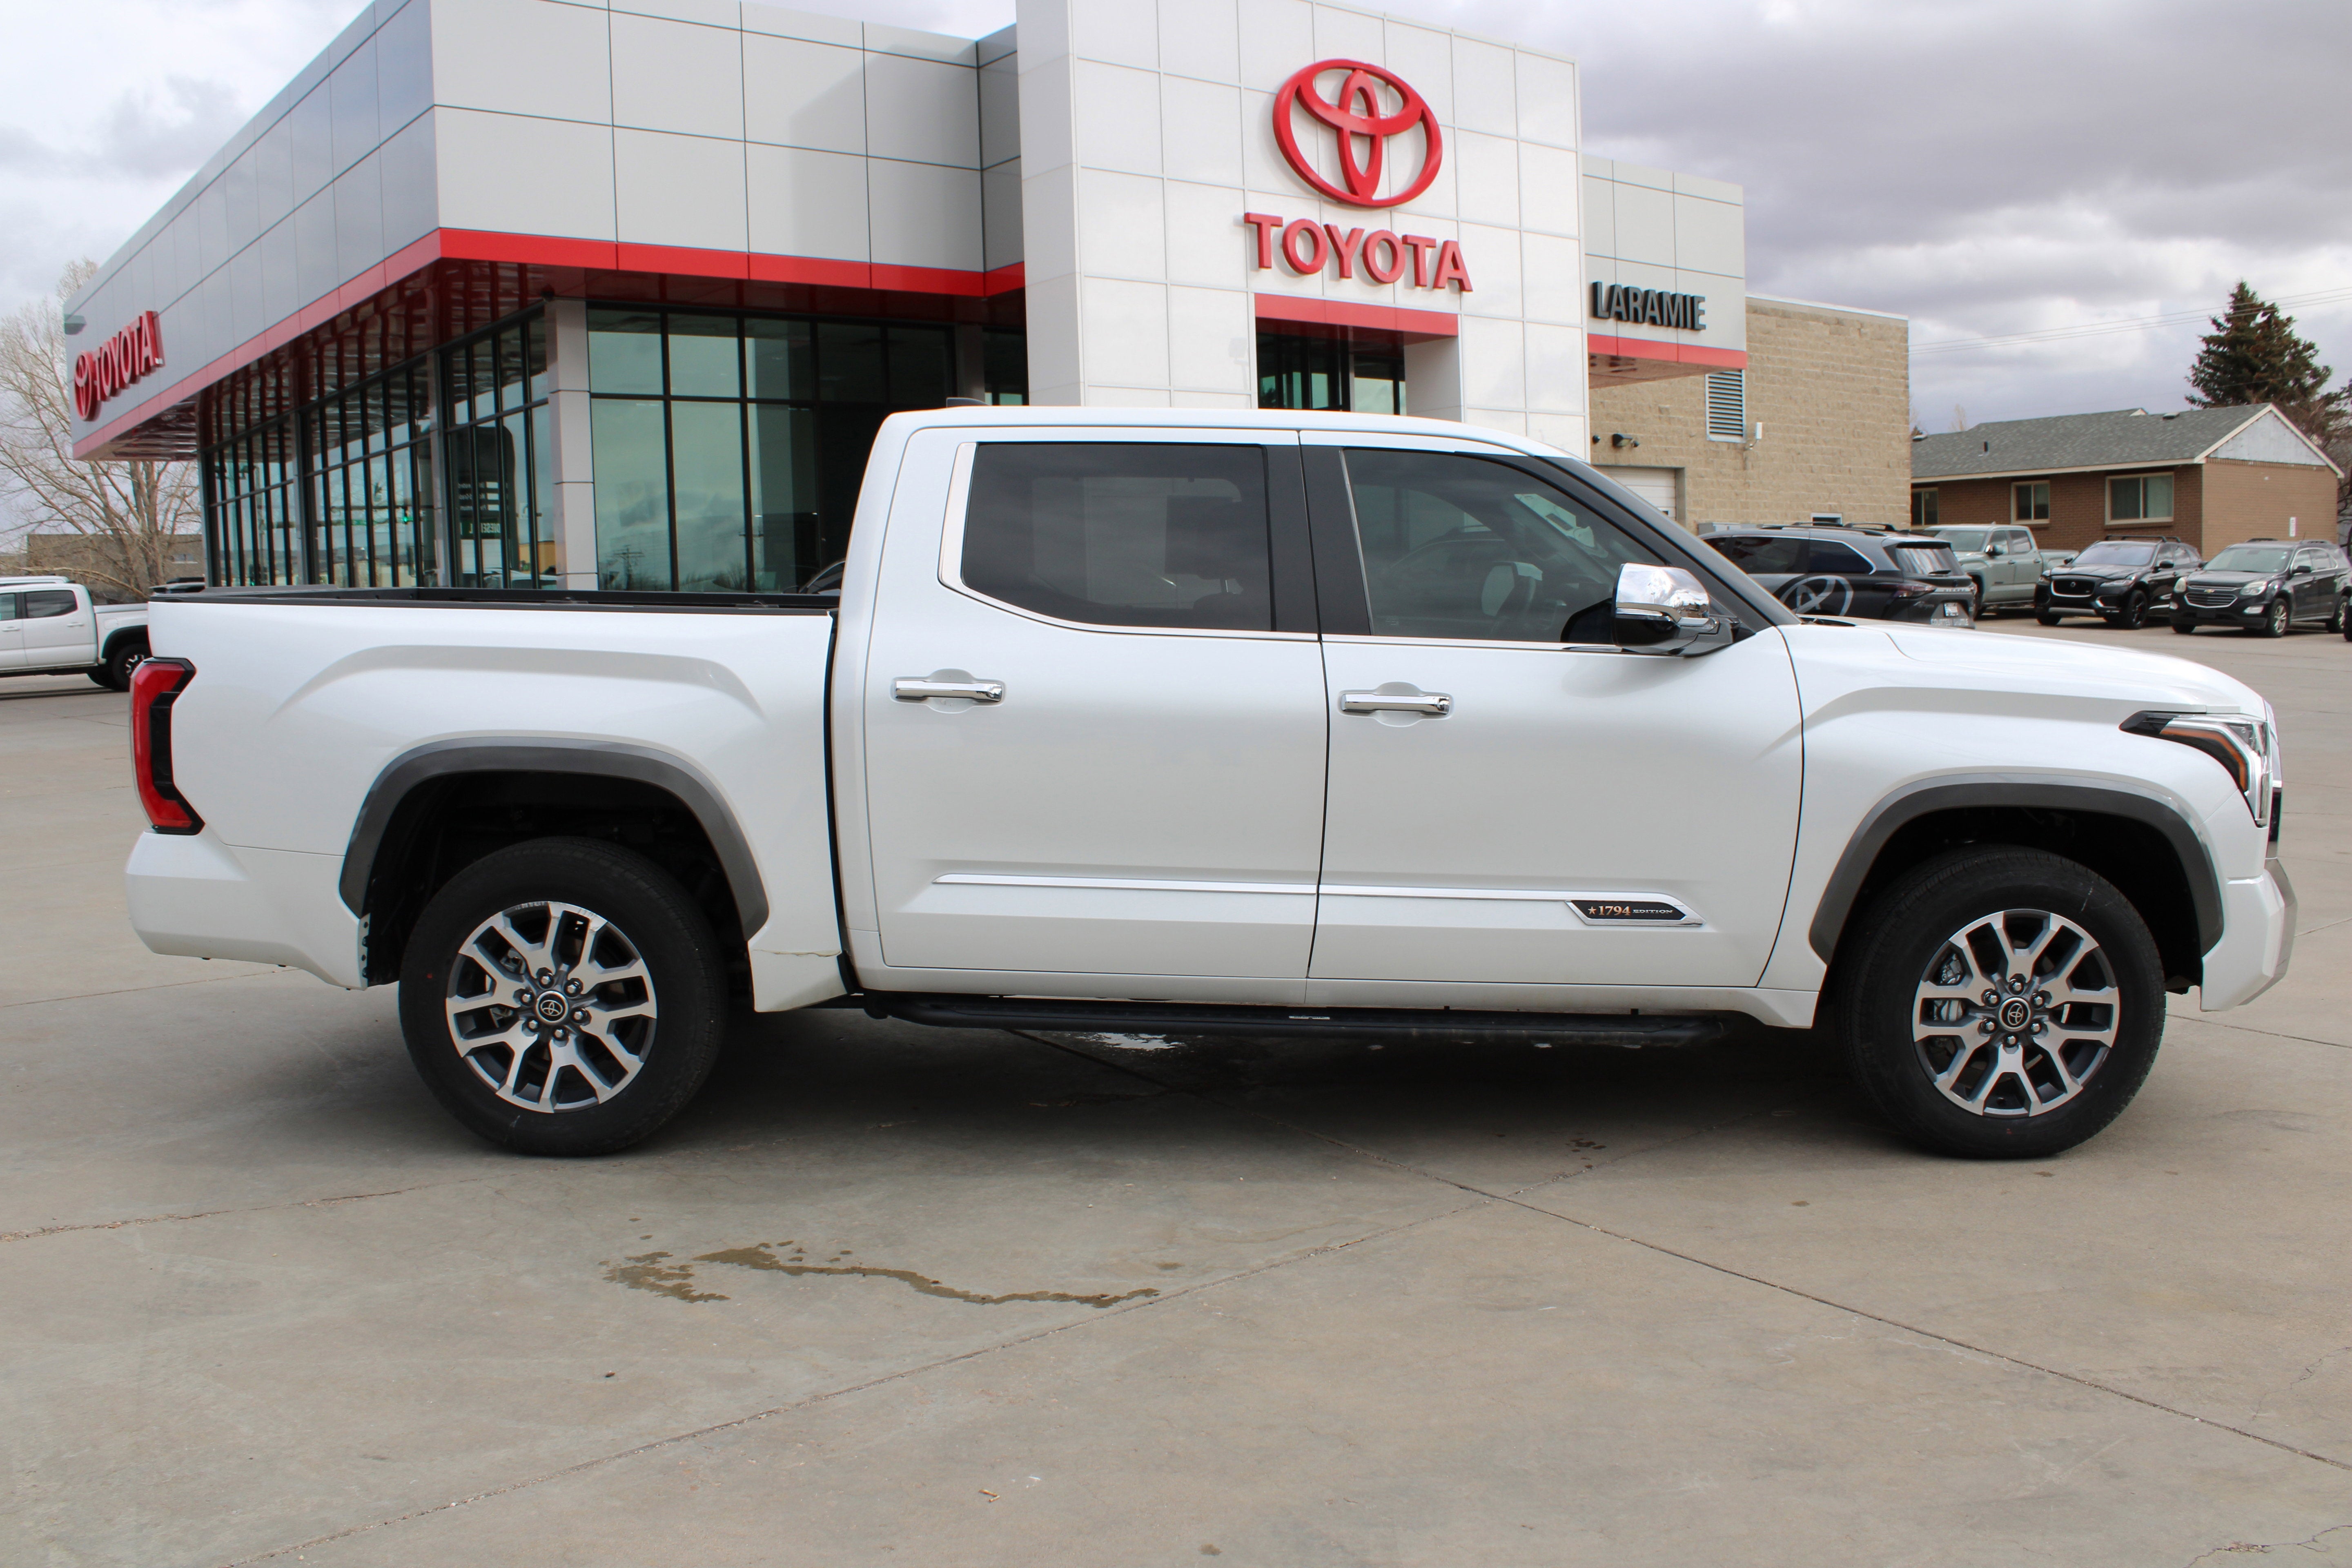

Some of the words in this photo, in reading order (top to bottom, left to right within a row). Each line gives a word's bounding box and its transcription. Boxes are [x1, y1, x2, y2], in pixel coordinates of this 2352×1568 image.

[1244, 212, 1473, 292] TOYOTA
[1591, 281, 1706, 330] LARAMIE
[93, 311, 165, 401] TOYOTA
[1598, 906, 1630, 916] 1794
